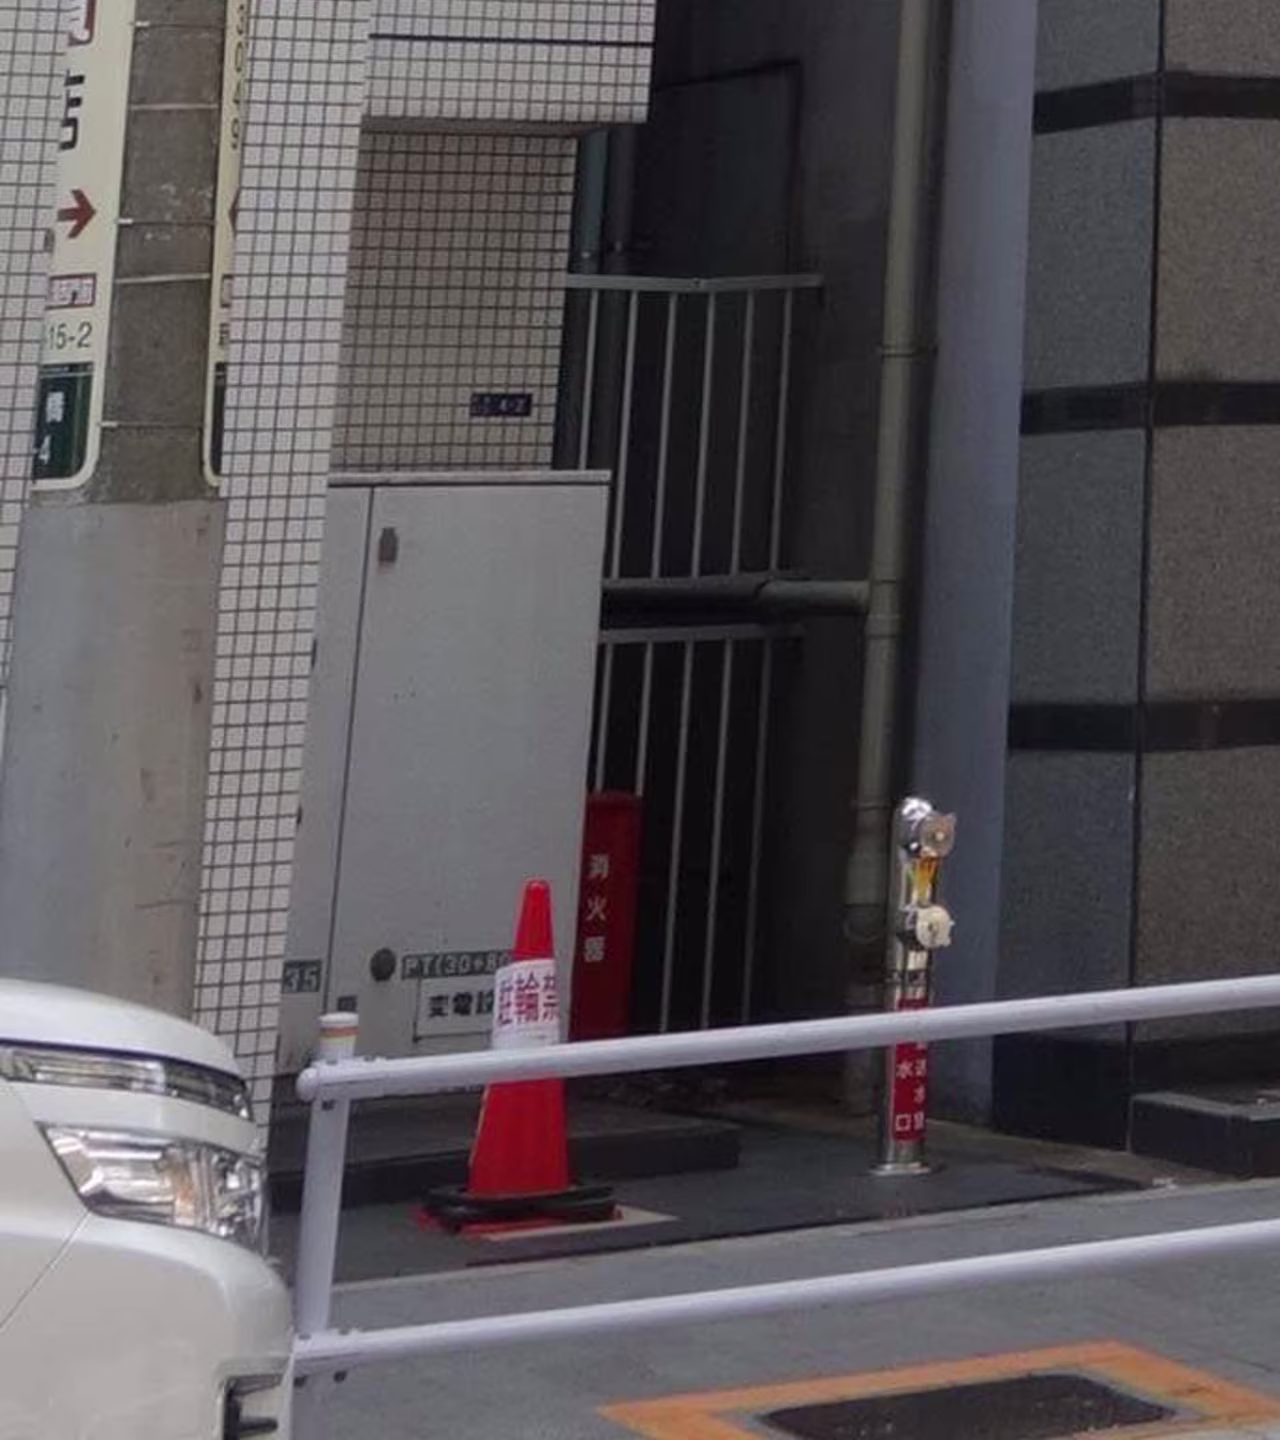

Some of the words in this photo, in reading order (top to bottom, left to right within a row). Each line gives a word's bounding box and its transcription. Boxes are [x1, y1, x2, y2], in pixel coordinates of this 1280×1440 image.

[583, 851, 609, 962] 消火器
[284, 966, 318, 992] 35
